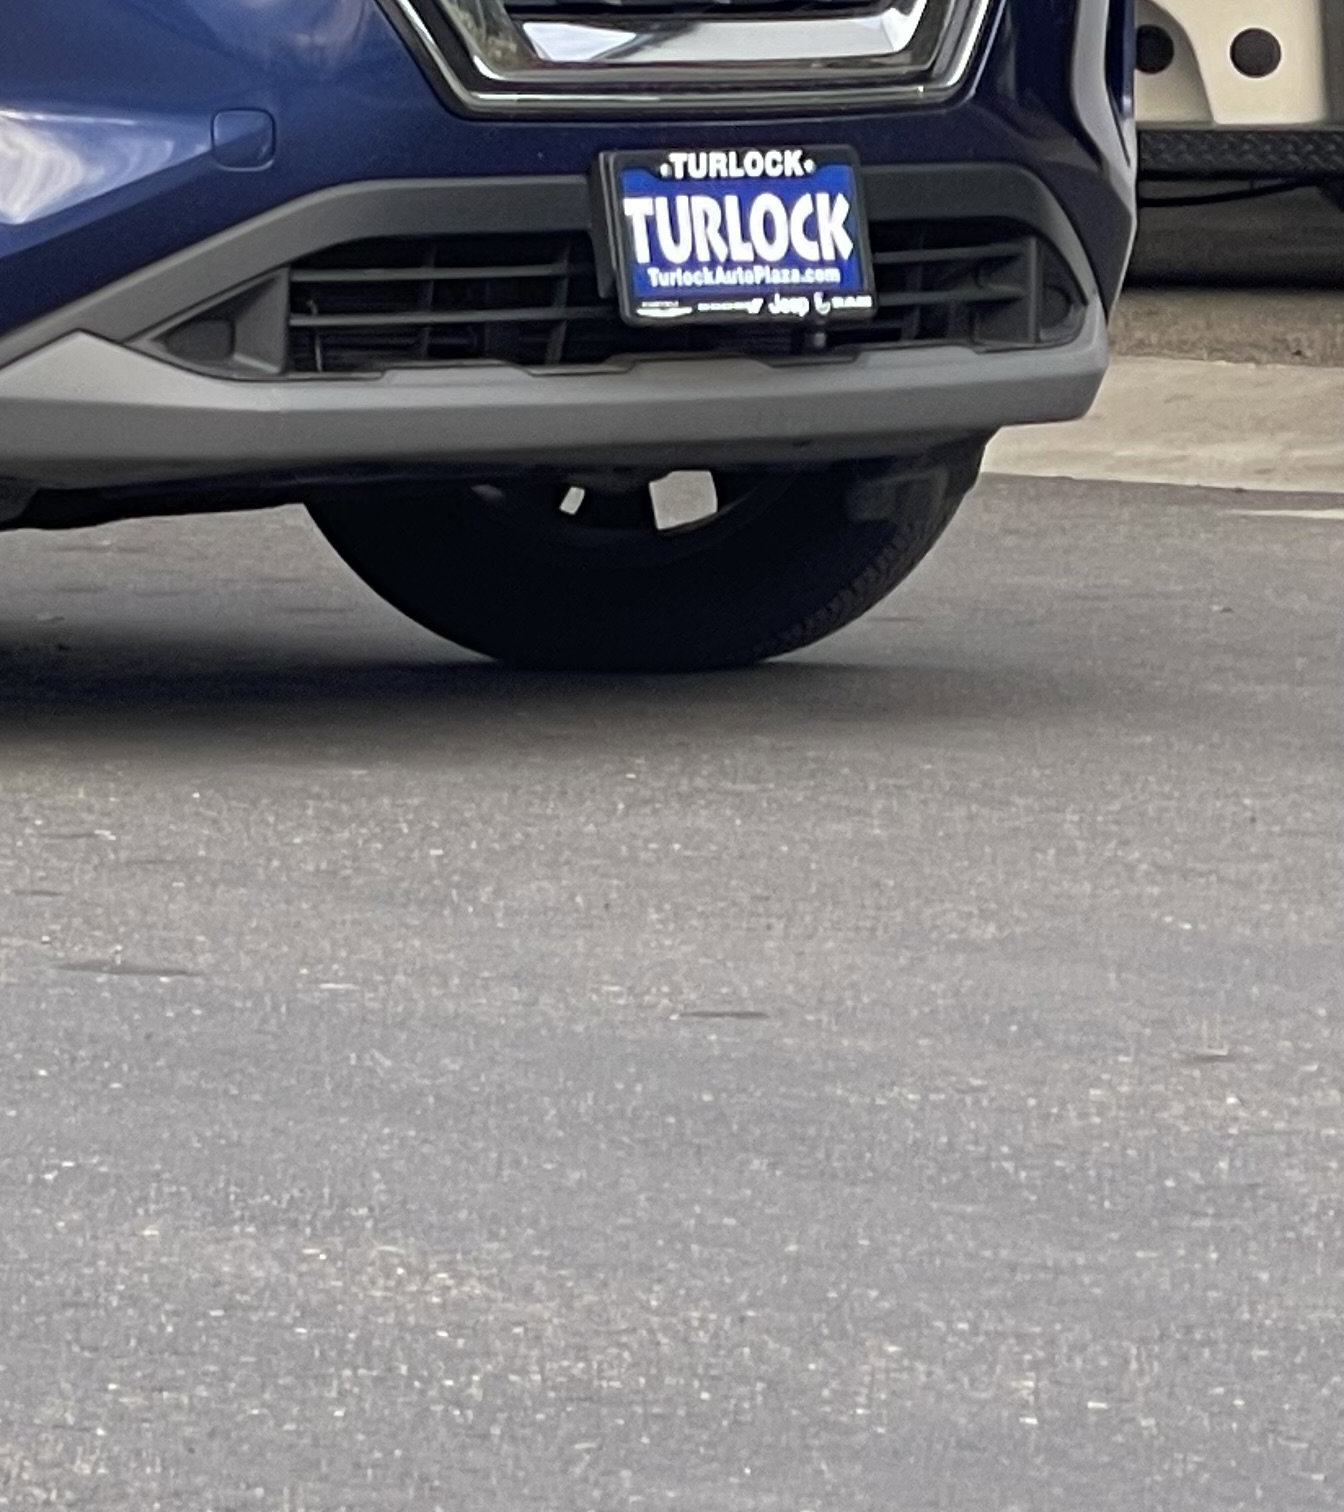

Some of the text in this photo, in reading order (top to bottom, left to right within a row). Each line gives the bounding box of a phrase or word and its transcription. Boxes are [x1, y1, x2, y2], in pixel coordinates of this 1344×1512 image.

[668, 149, 805, 180] TURLOCK
[623, 191, 854, 265] TURLOCK
[646, 265, 842, 289] TurlockAutoPlaza.com
